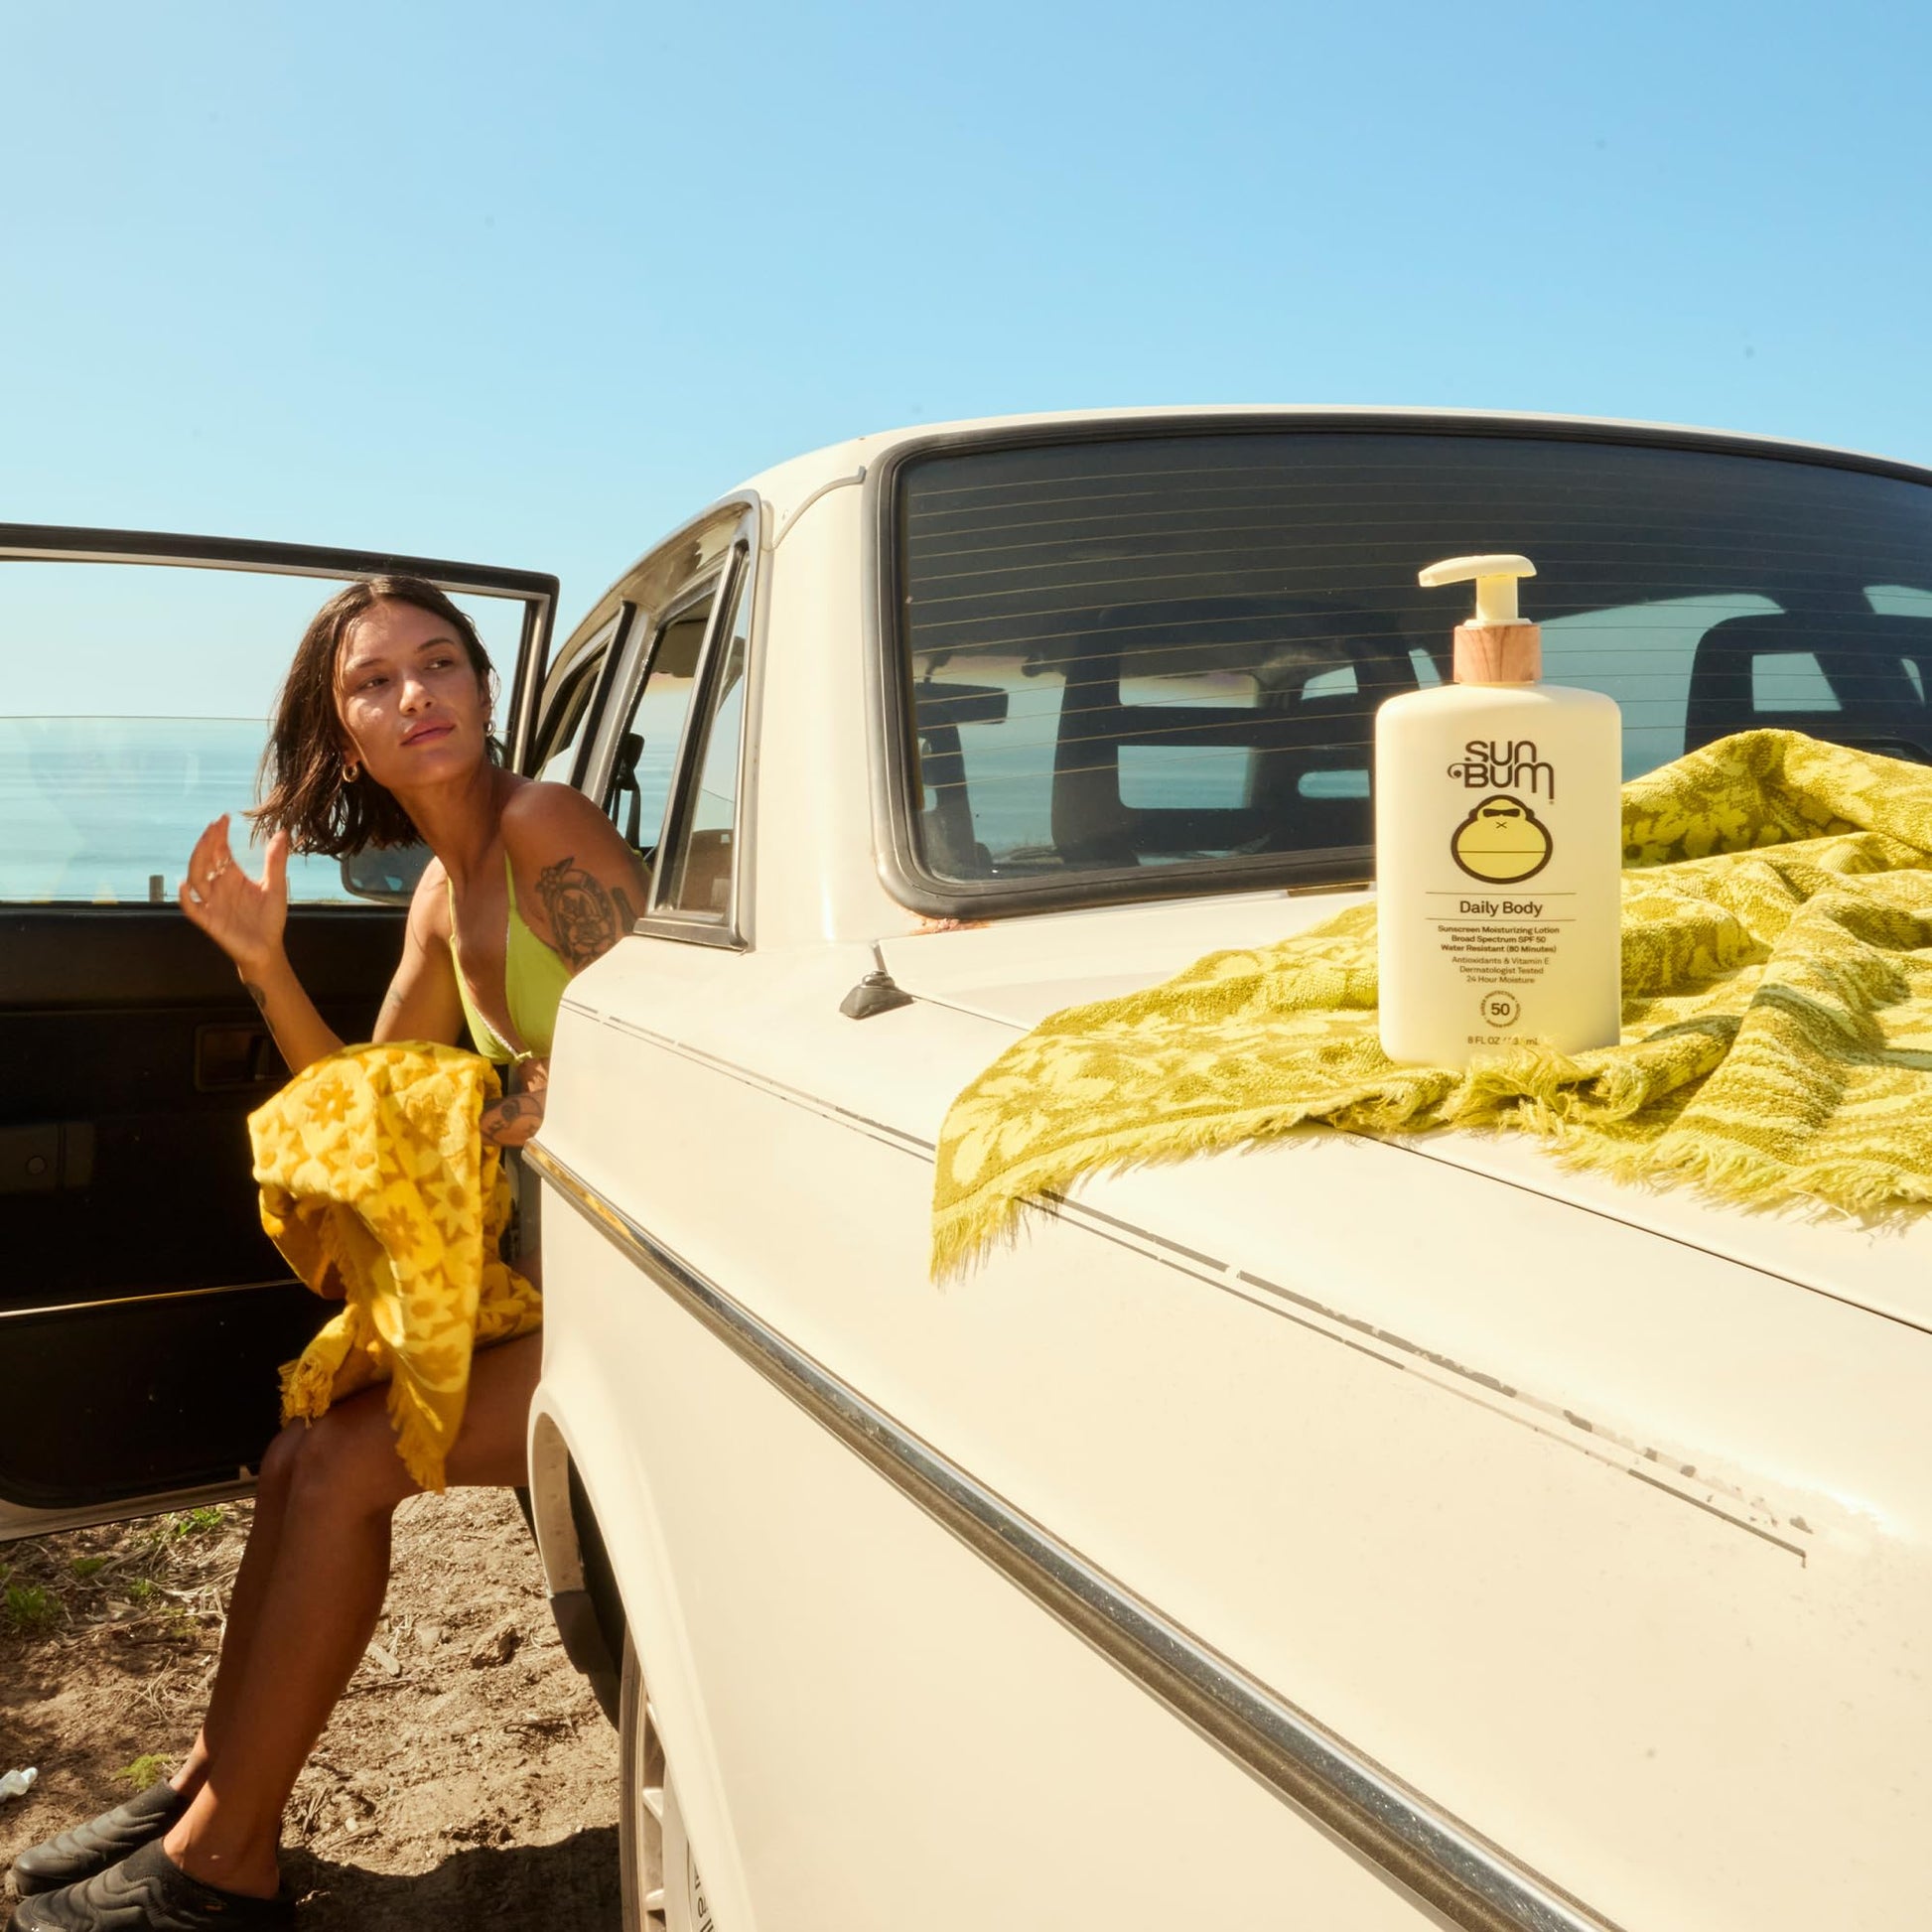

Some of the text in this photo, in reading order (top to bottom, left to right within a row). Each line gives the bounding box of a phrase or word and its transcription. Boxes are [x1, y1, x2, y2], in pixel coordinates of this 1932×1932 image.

[1459, 899, 1544, 918] Daily Body
[1438, 924, 1481, 933] Sunscreen
[1481, 925, 1534, 936] Moisturizing
[1476, 935, 1517, 944] Spectrum
[1465, 944, 1505, 953] Resistant
[1506, 945, 1520, 954] (80
[1520, 944, 1557, 954] Minutes)
[1451, 956, 1502, 965] Antioxidants
[1544, 956, 1550, 965] E
[1459, 965, 1544, 976] Dermatologist Tested
[1477, 975, 1497, 984] Hour
[1490, 1002, 1511, 1017] 50
[1467, 1035, 1474, 1044] 8
[1475, 1035, 1486, 1045] FL
[1487, 1035, 1501, 1045] OZ
